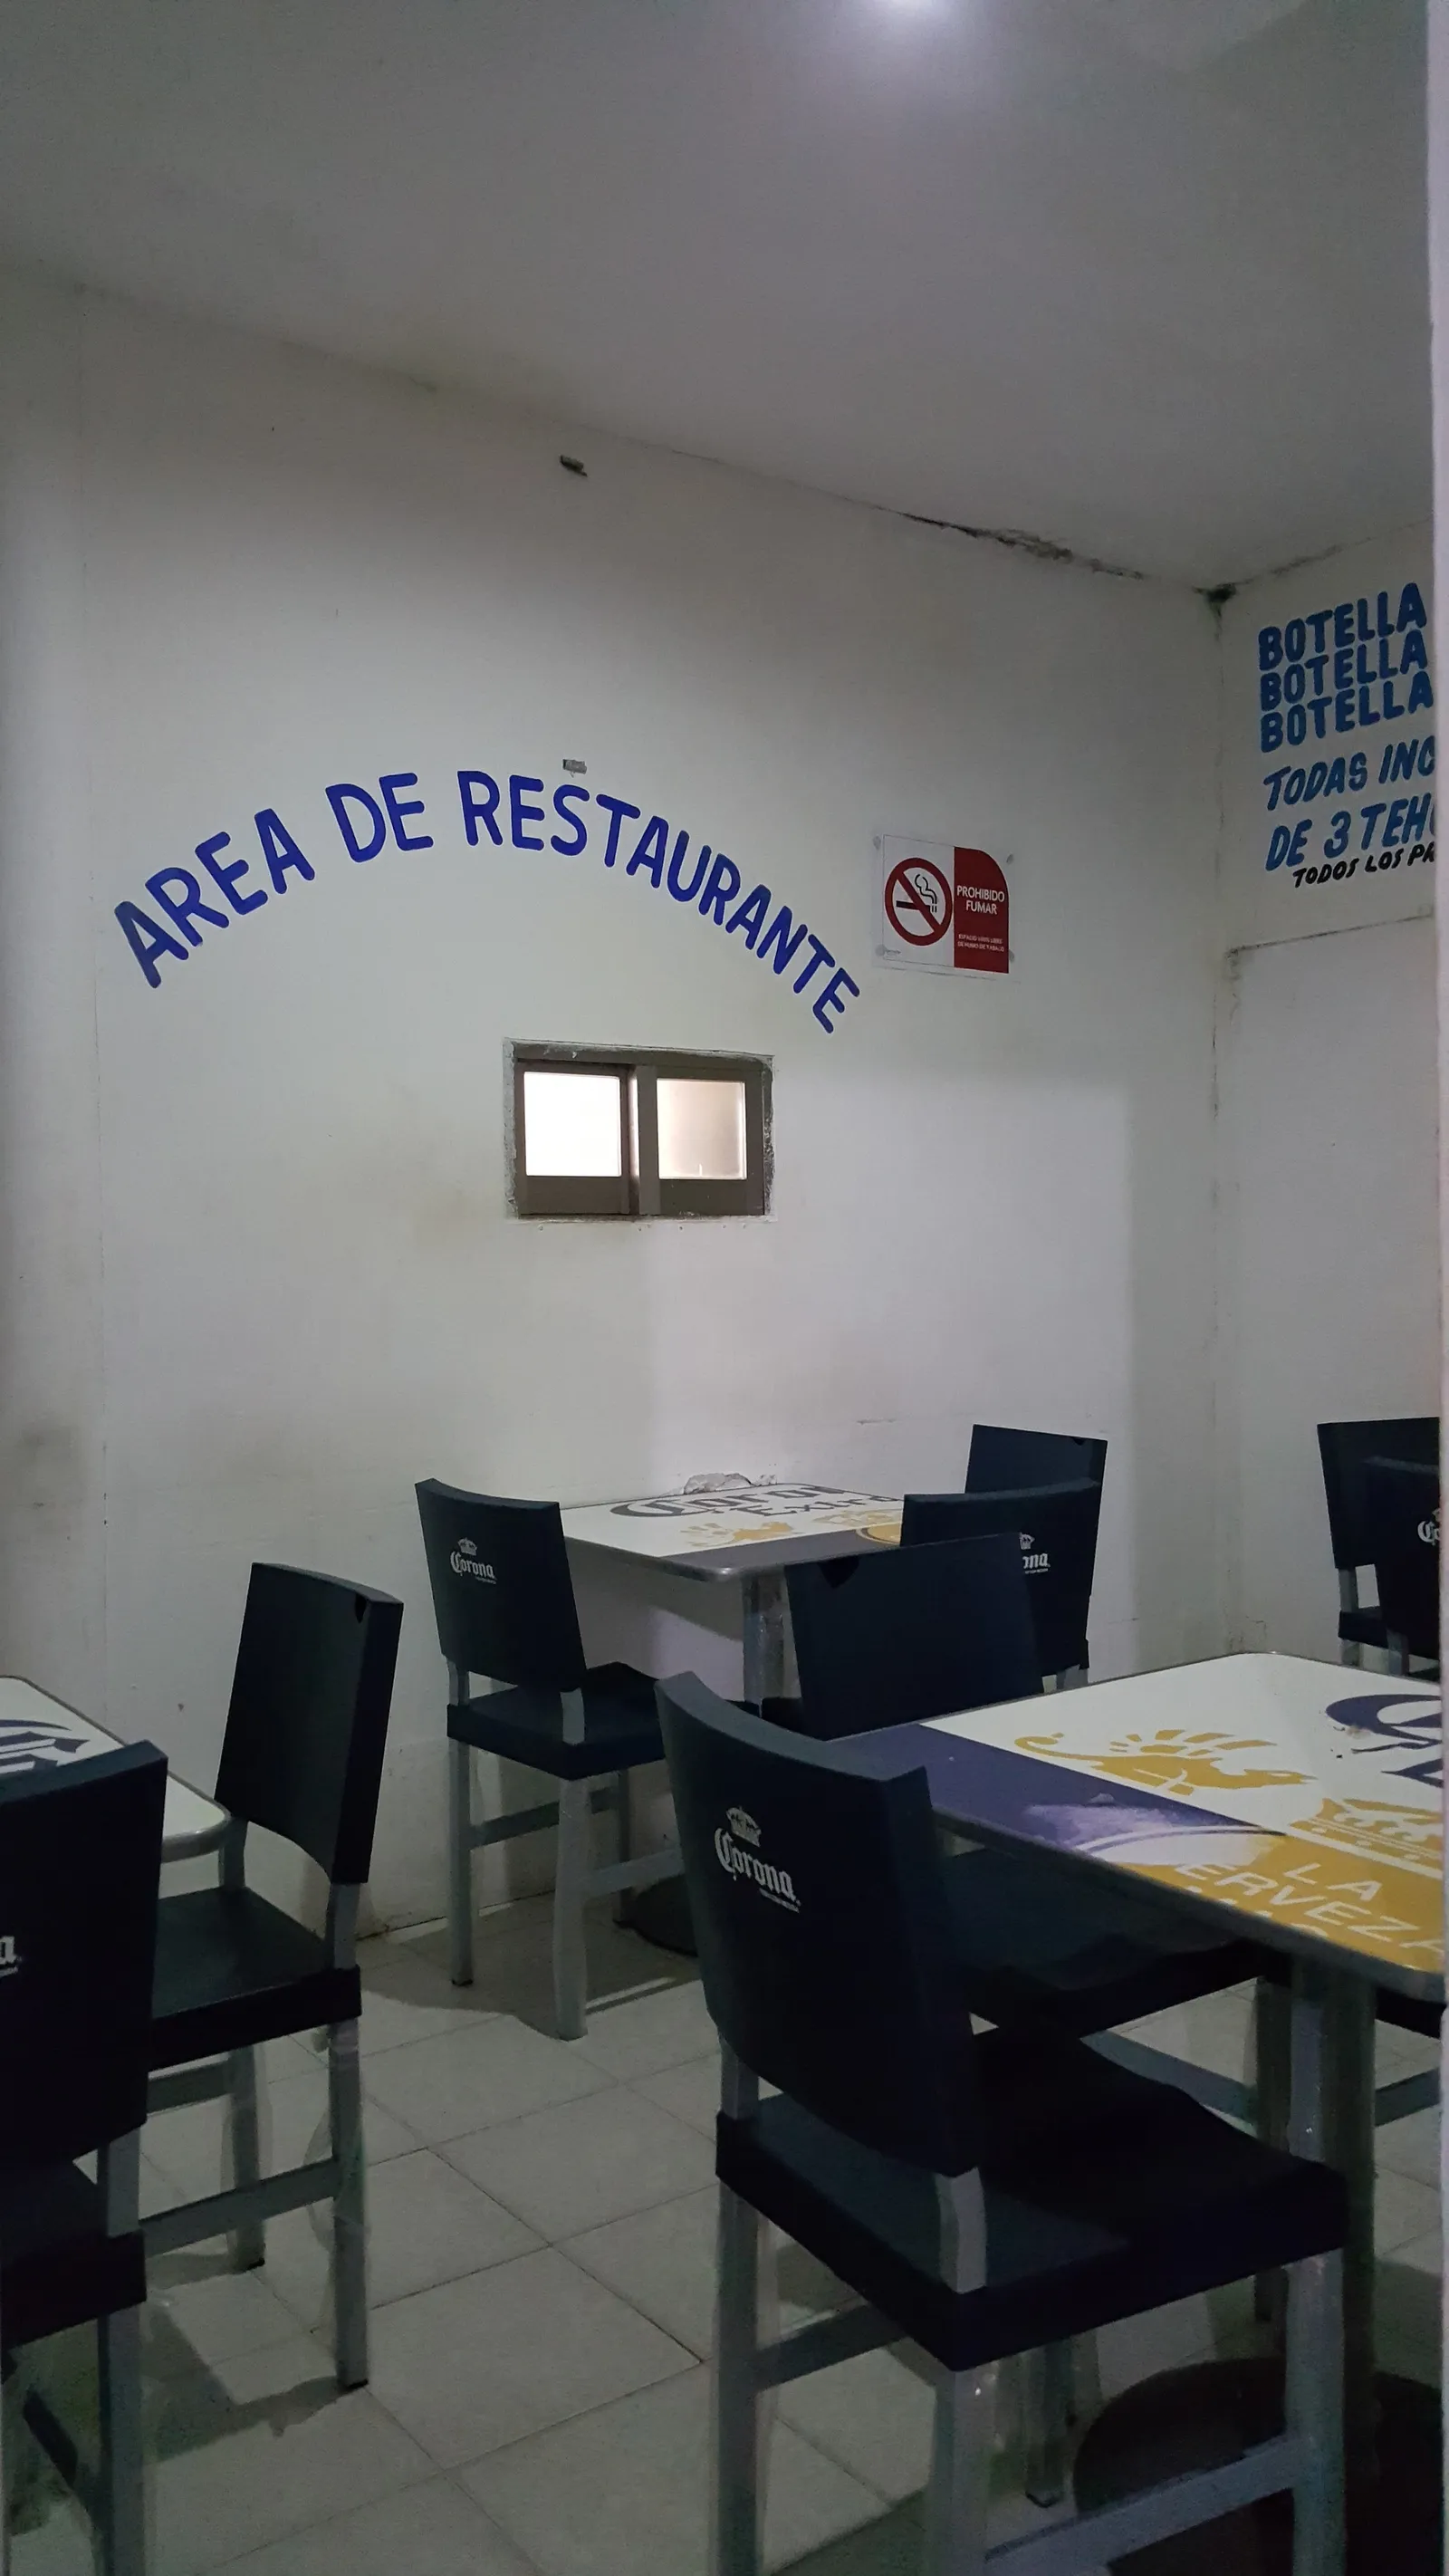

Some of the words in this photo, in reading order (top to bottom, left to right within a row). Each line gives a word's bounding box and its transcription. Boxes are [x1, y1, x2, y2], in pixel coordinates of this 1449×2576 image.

[1258, 582, 1427, 671] BOTELLA
[1260, 629, 1428, 712] BOTELLA
[1261, 670, 1435, 754] BOTELLA
[1263, 752, 1367, 812] TODAS
[1265, 818, 1313, 872] DE
[1324, 811, 1352, 860] 3
[1292, 858, 1360, 889] TODOS
[1364, 848, 1405, 873] LOS
[114, 808, 315, 989] AREA
[325, 772, 435, 863] DE
[456, 769, 860, 1034] RESTAURANTE
[956, 885, 1005, 903] PROHIBIDO
[965, 899, 998, 915] FUMAR
[450, 1551, 497, 1581] Corona
[714, 1828, 799, 1904] Corona
[1283, 1862, 1383, 1902] LA
